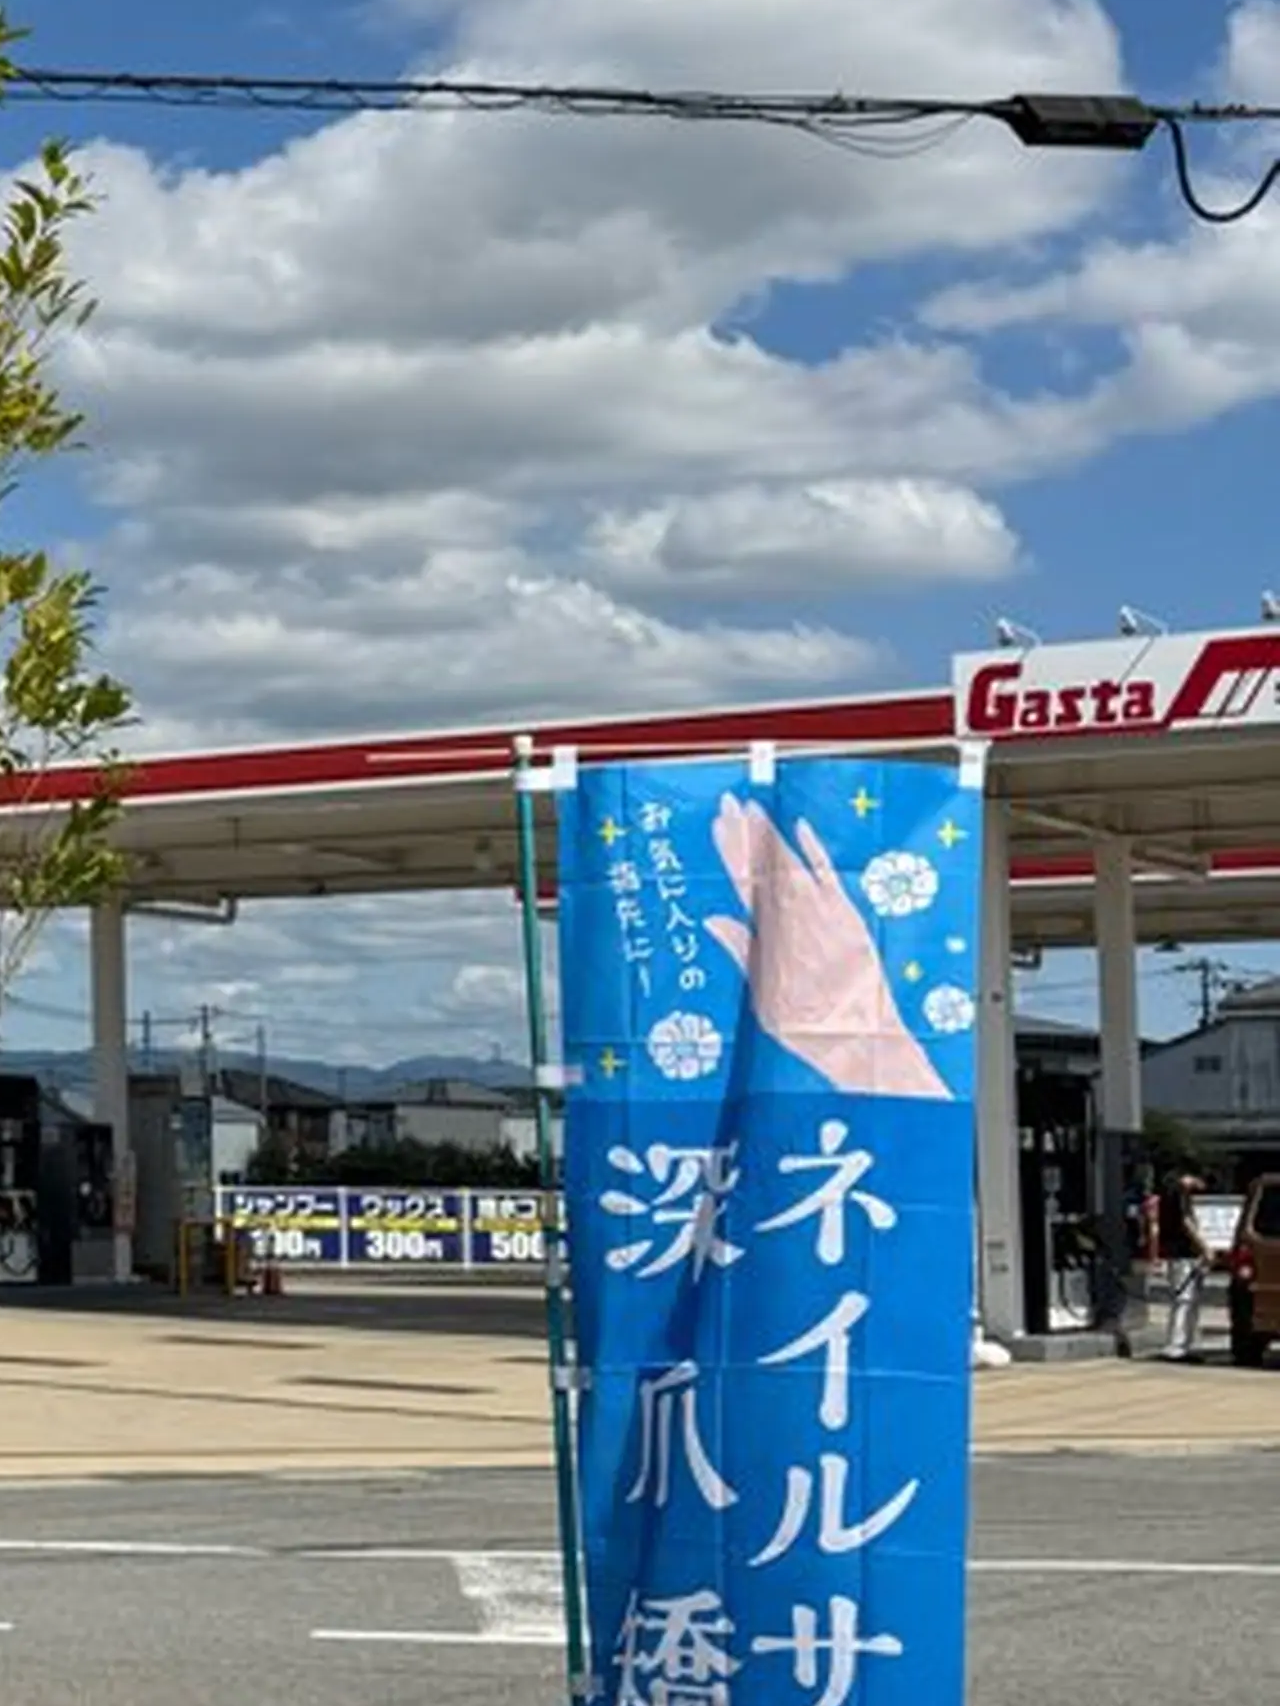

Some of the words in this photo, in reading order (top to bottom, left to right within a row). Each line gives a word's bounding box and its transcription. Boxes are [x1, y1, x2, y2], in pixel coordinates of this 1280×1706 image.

[966, 661, 1155, 732] Gasta
[639, 801, 705, 991] お気に入りの
[360, 1194, 444, 1216] ワックス
